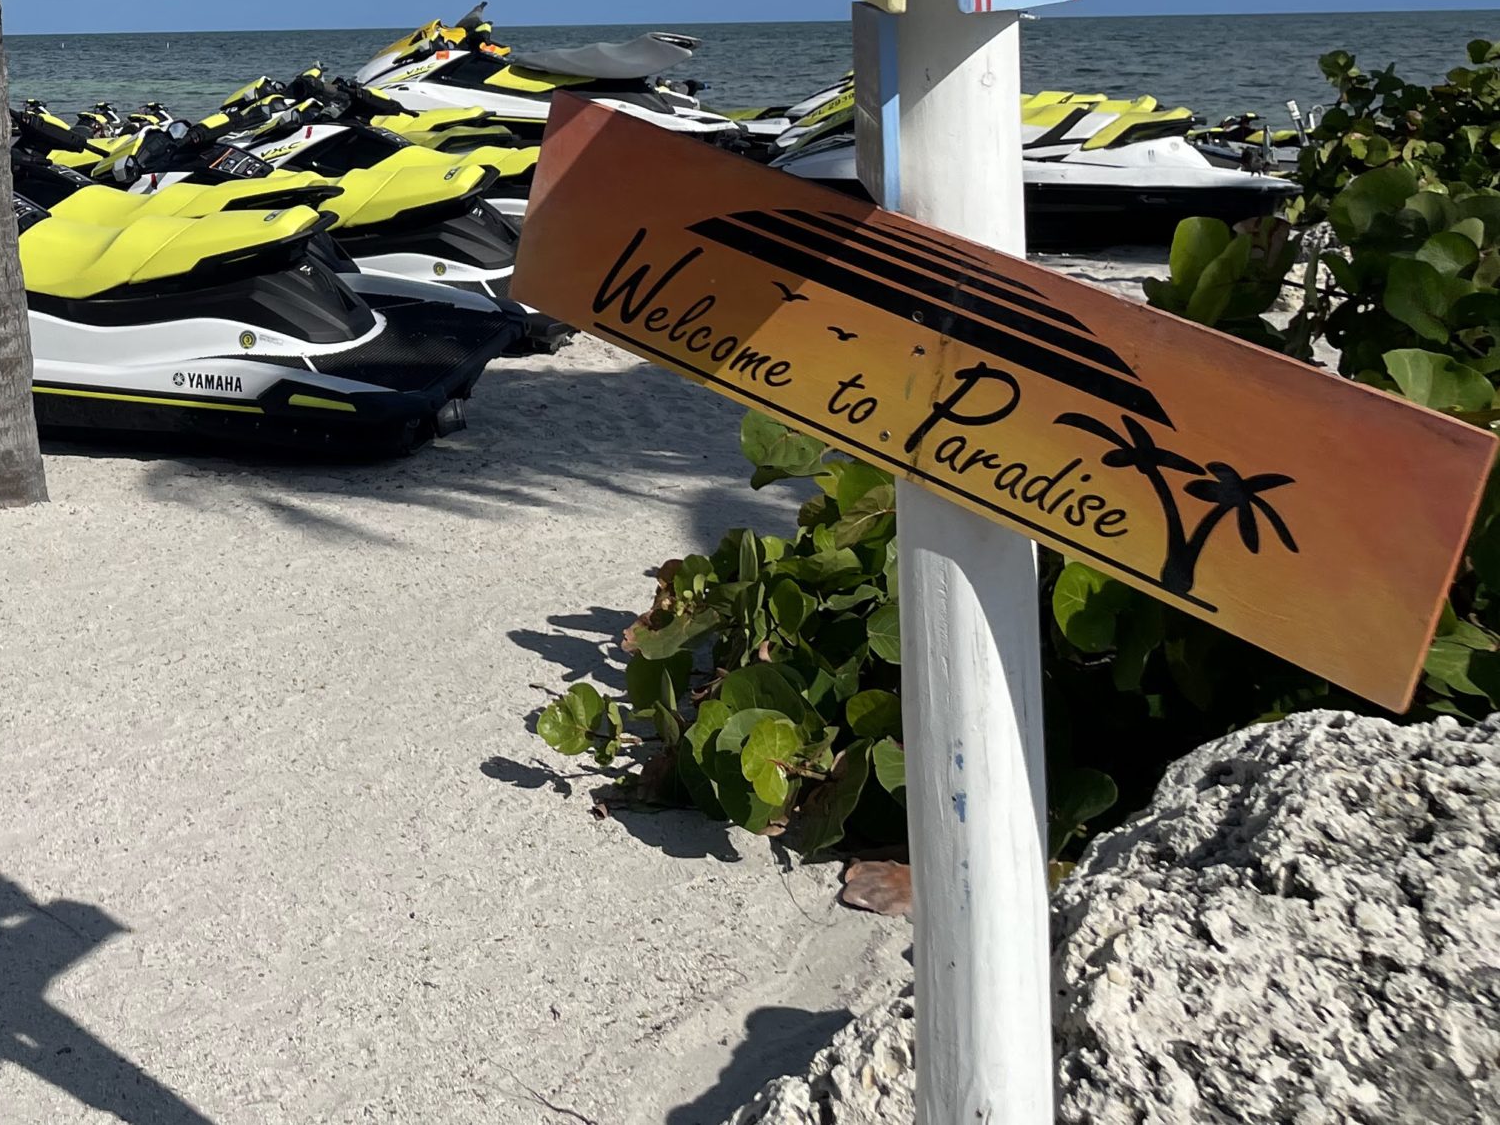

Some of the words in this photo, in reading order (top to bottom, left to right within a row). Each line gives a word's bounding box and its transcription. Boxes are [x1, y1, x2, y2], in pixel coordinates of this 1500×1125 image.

[187, 372, 243, 393] YAMAHA
[592, 227, 792, 387] Welcome
[827, 373, 878, 424] to
[903, 361, 1129, 538] Paradise
